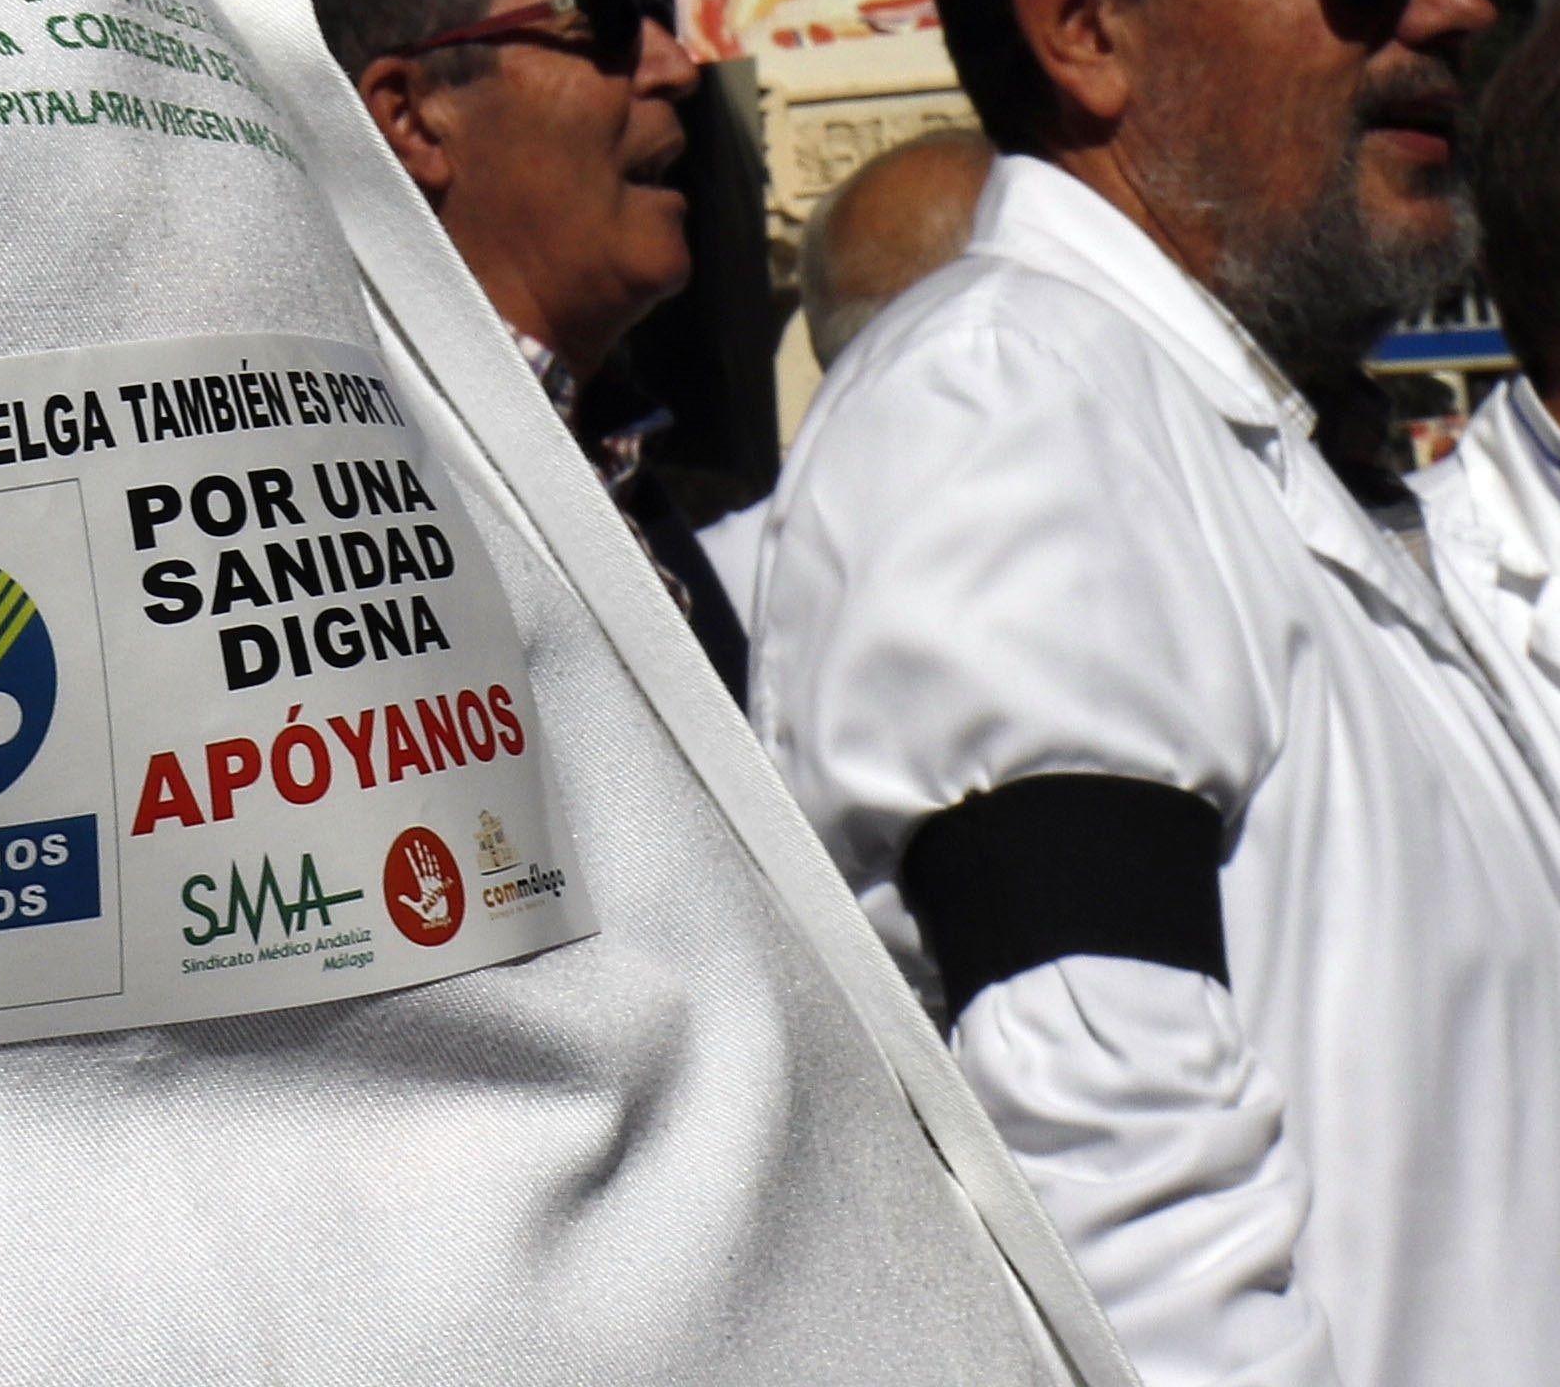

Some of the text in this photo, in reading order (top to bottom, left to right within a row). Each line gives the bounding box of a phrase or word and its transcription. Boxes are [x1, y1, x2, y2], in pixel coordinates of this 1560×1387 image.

[119, 359, 292, 443] TAMBIÉN
[287, 371, 330, 424] ES
[326, 372, 385, 424] POR
[368, 376, 406, 427] TI
[126, 458, 436, 552] POR UNA
[141, 523, 455, 624] SANIDAD
[220, 594, 450, 691] DIGNA
[129, 684, 525, 837] APÓYANOS
[182, 852, 364, 946] SMA
[182, 950, 254, 975] Sindicato
[259, 939, 311, 962] Médico
